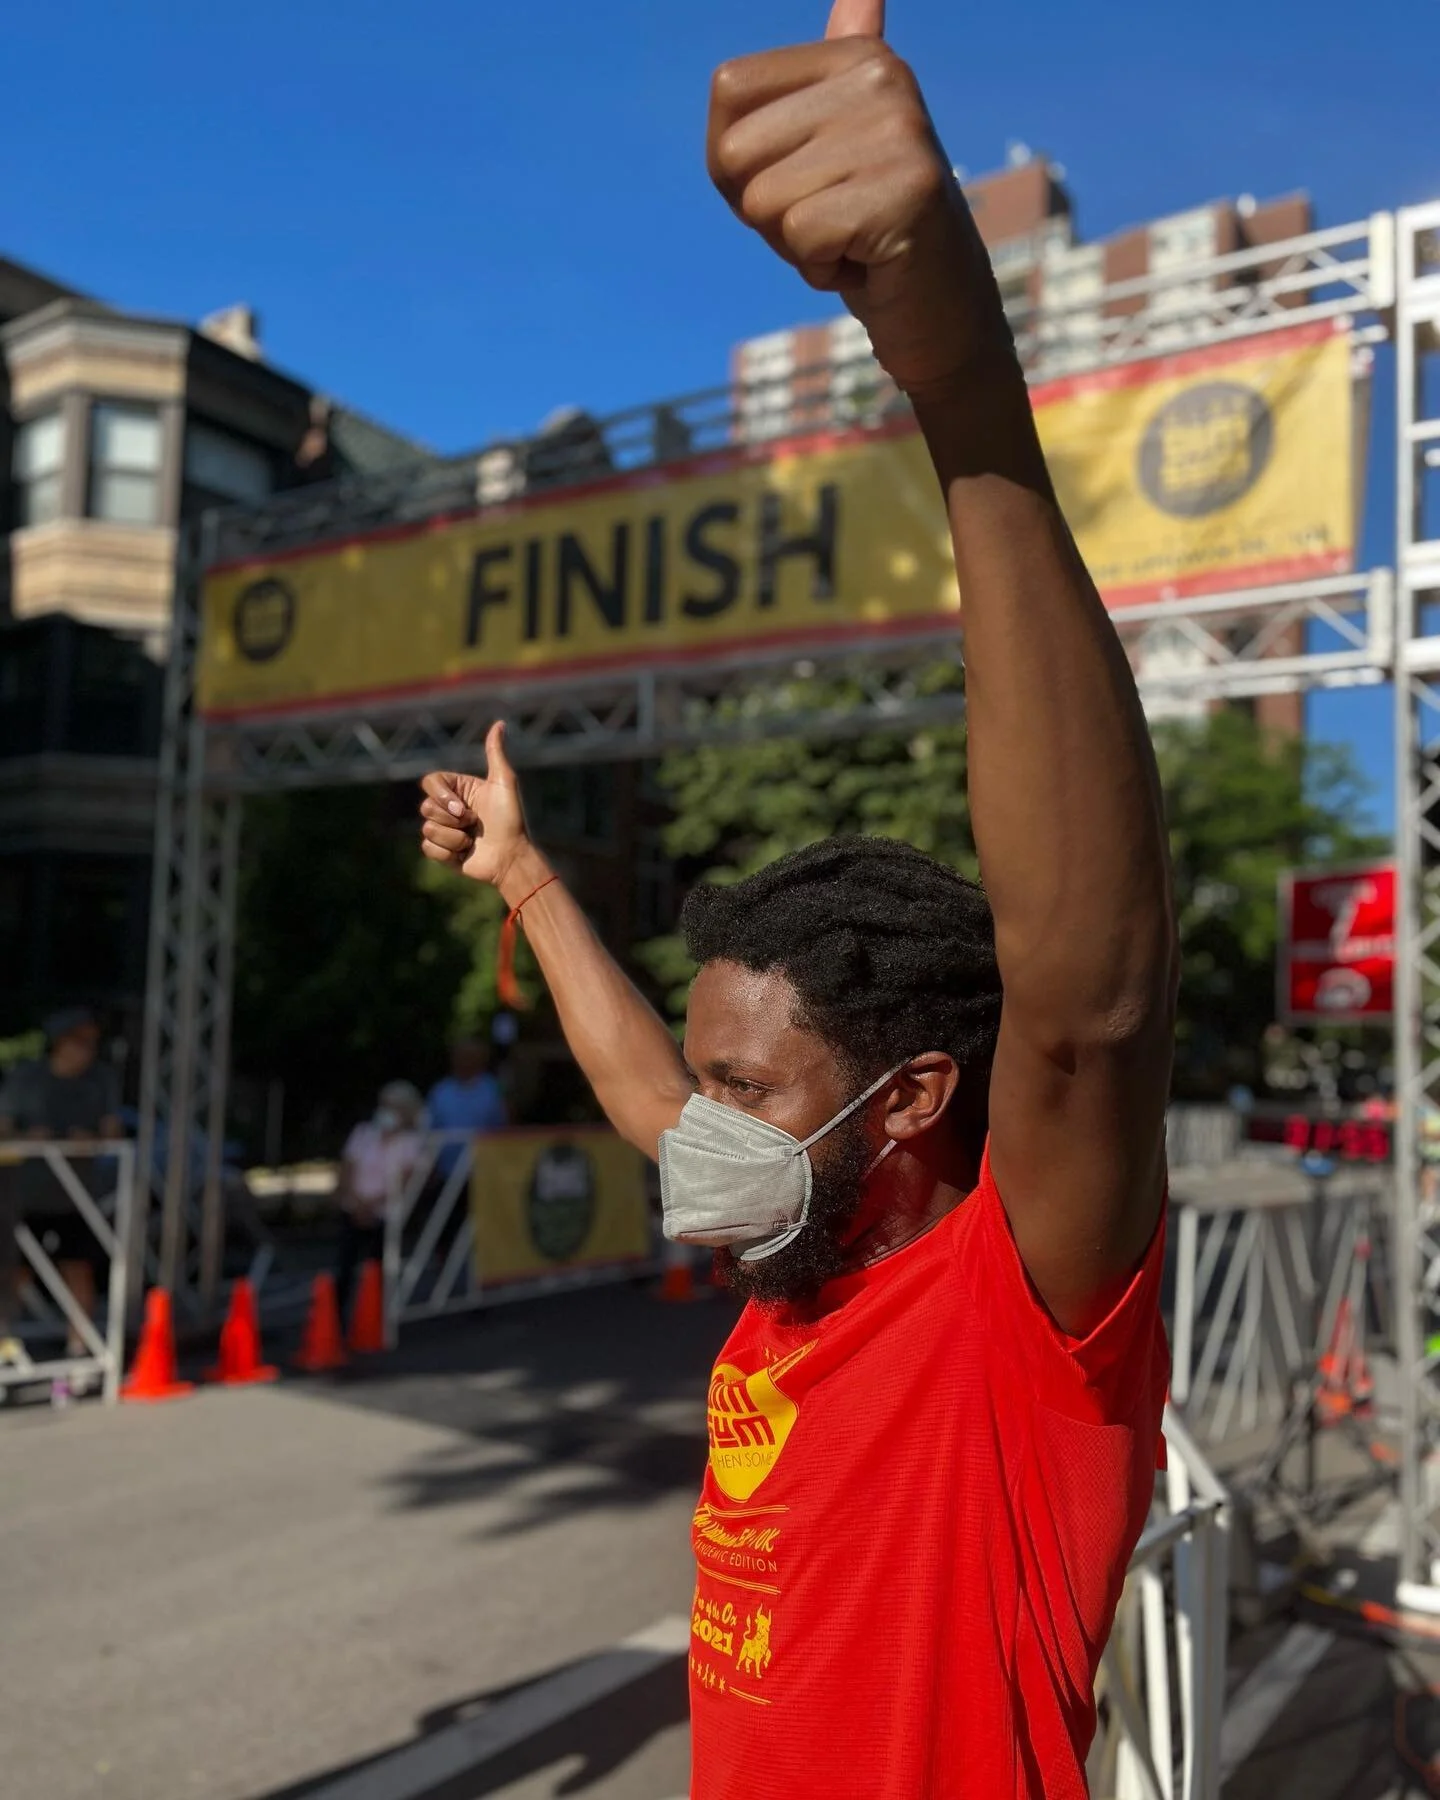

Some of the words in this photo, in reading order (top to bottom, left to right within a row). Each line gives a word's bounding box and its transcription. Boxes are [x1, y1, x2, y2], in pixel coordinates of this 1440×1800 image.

[464, 484, 839, 648] FINISH
[730, 1553, 777, 1572] EDITION
[691, 1612, 734, 1657] 2021
